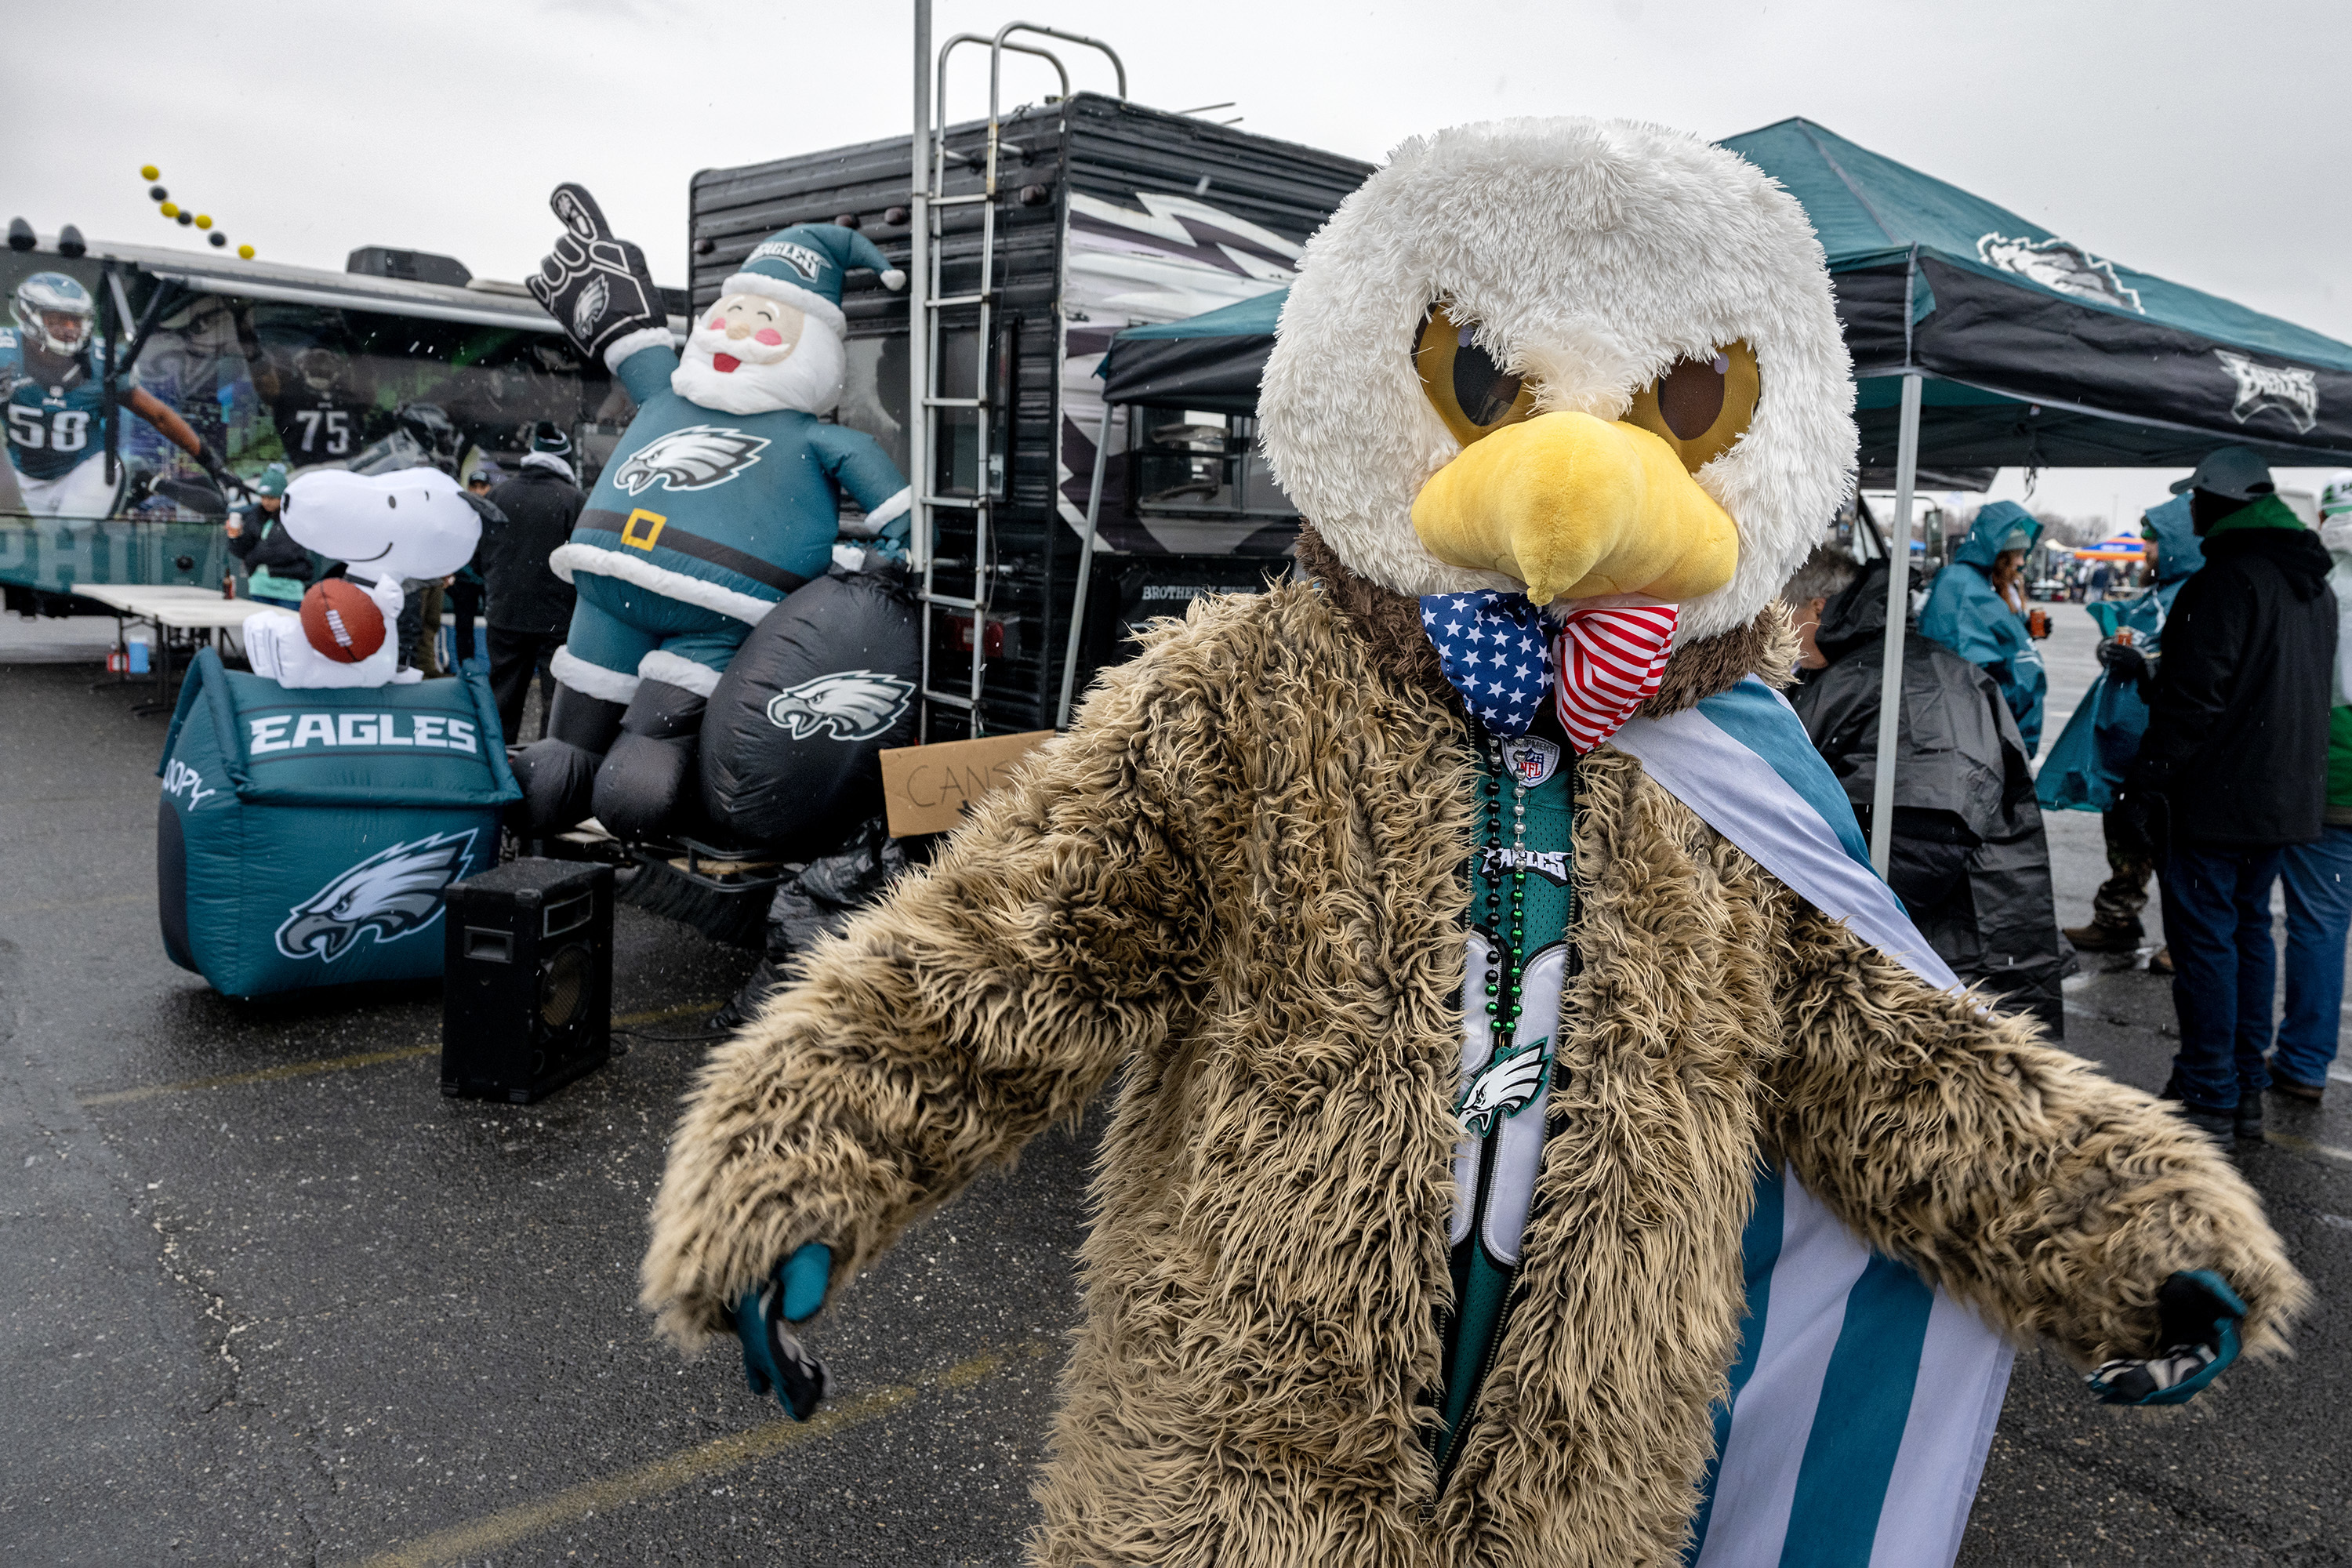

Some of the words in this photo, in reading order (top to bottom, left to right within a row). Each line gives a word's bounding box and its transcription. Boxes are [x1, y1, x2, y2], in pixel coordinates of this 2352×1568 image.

[8, 403, 90, 452] 58
[296, 410, 350, 454] 75
[248, 713, 477, 756] EAGLES
[1519, 761, 1541, 778] NFL
